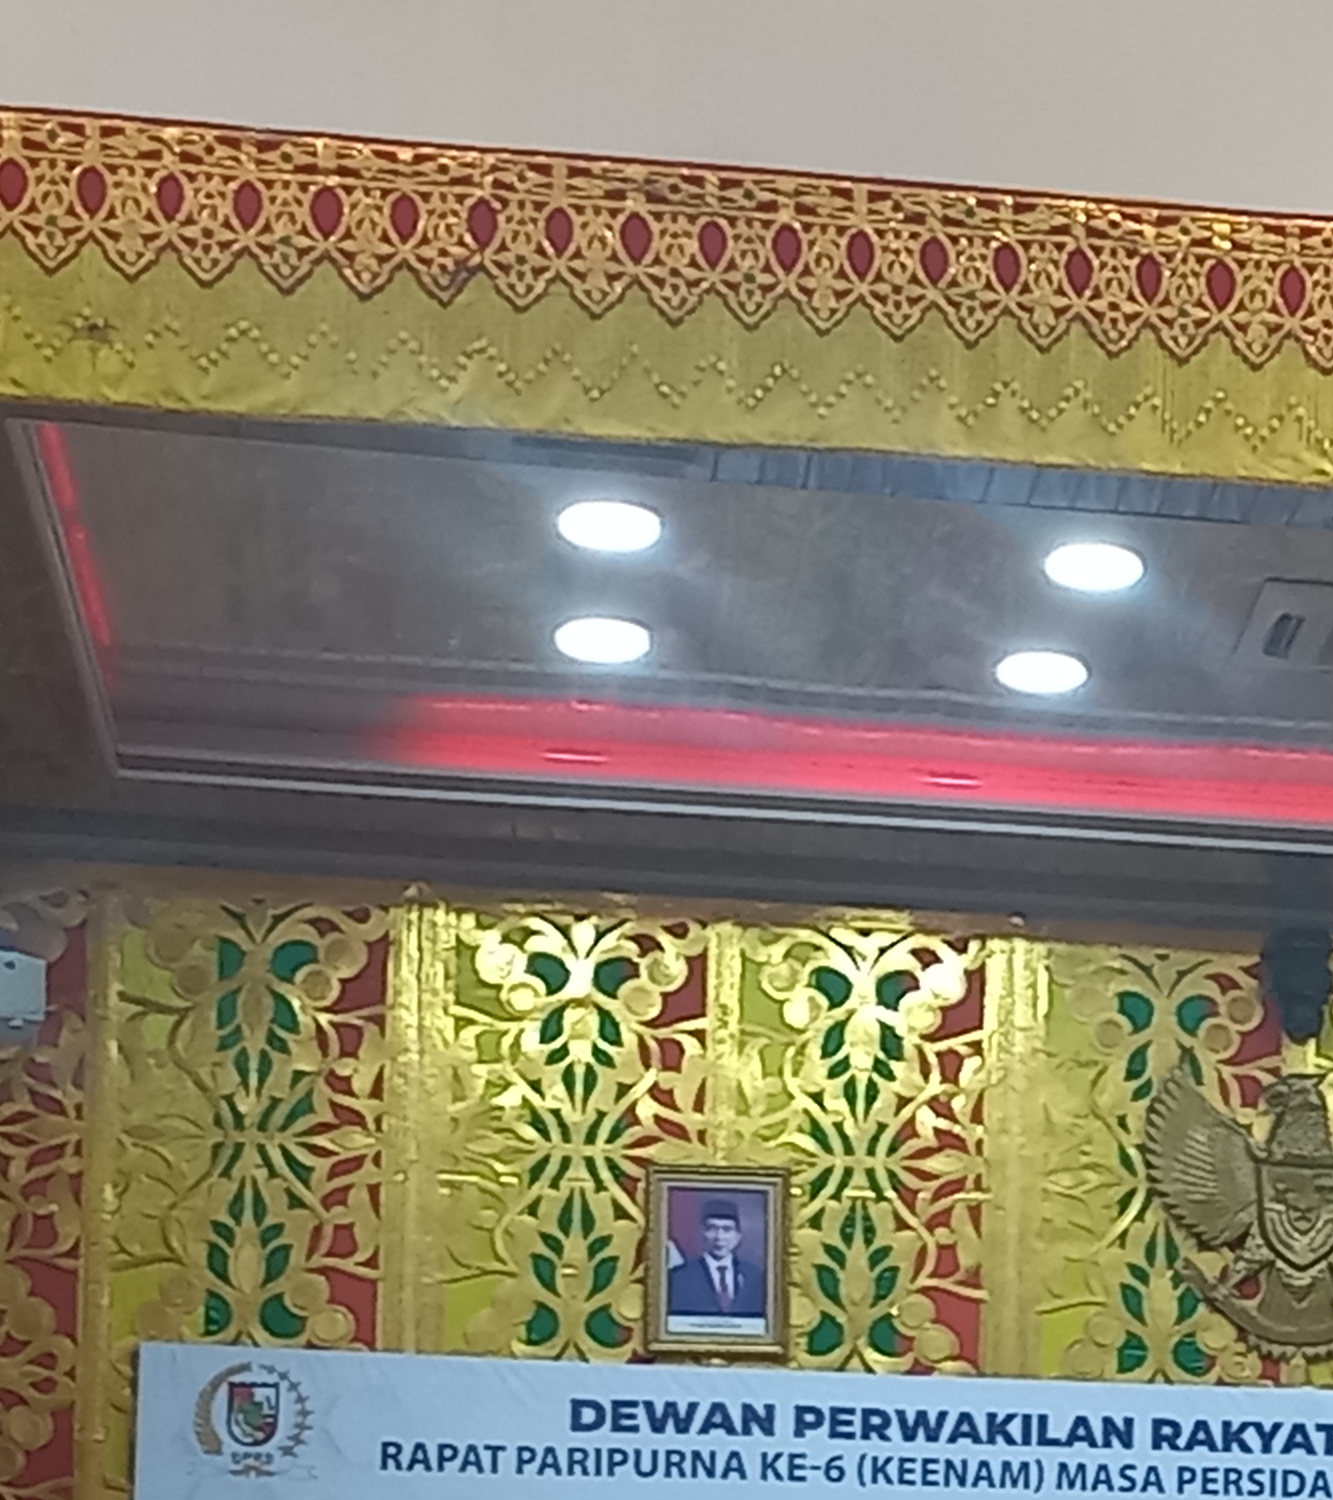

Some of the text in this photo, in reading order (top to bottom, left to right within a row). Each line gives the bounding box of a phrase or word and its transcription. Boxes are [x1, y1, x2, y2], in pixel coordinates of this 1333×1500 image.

[570, 1398, 775, 1437] DEWAN
[793, 1404, 1134, 1452] PERWAKILAN
[379, 1441, 507, 1474] RAPAT
[515, 1445, 748, 1480] PARIPURNA
[760, 1450, 846, 1483] KE-6
[856, 1453, 1044, 1493] (KEENAM)
[1056, 1462, 1165, 1494] MASA
